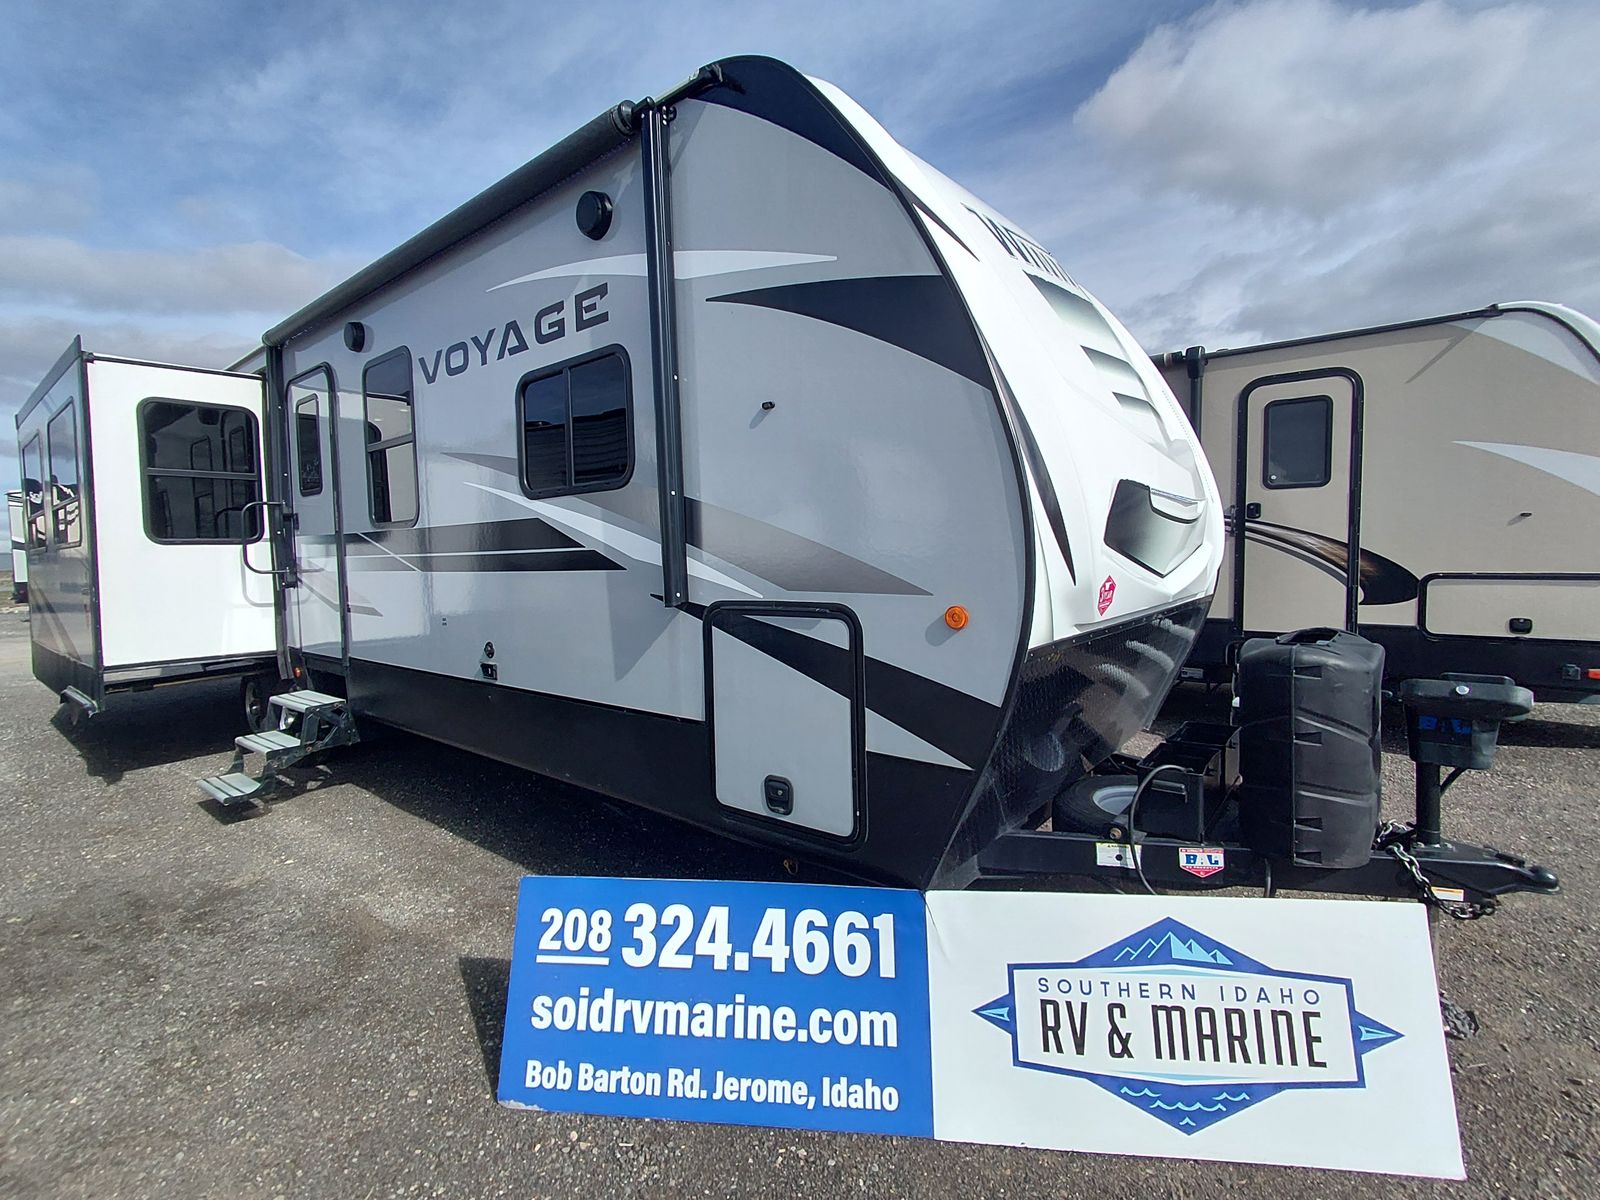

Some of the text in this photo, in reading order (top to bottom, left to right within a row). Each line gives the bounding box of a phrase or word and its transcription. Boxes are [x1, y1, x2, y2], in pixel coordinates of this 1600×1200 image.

[418, 282, 609, 385] VOYAGE
[538, 902, 896, 979] 208 324.4661
[530, 986, 898, 1047] soidrvmarine.com
[1038, 977, 1320, 1005] SOUTHERN IDAHO
[1039, 998, 1327, 1069] RV & MARINE
[525, 1059, 900, 1112] Bob Barton Rd. Jerome, Idaho
